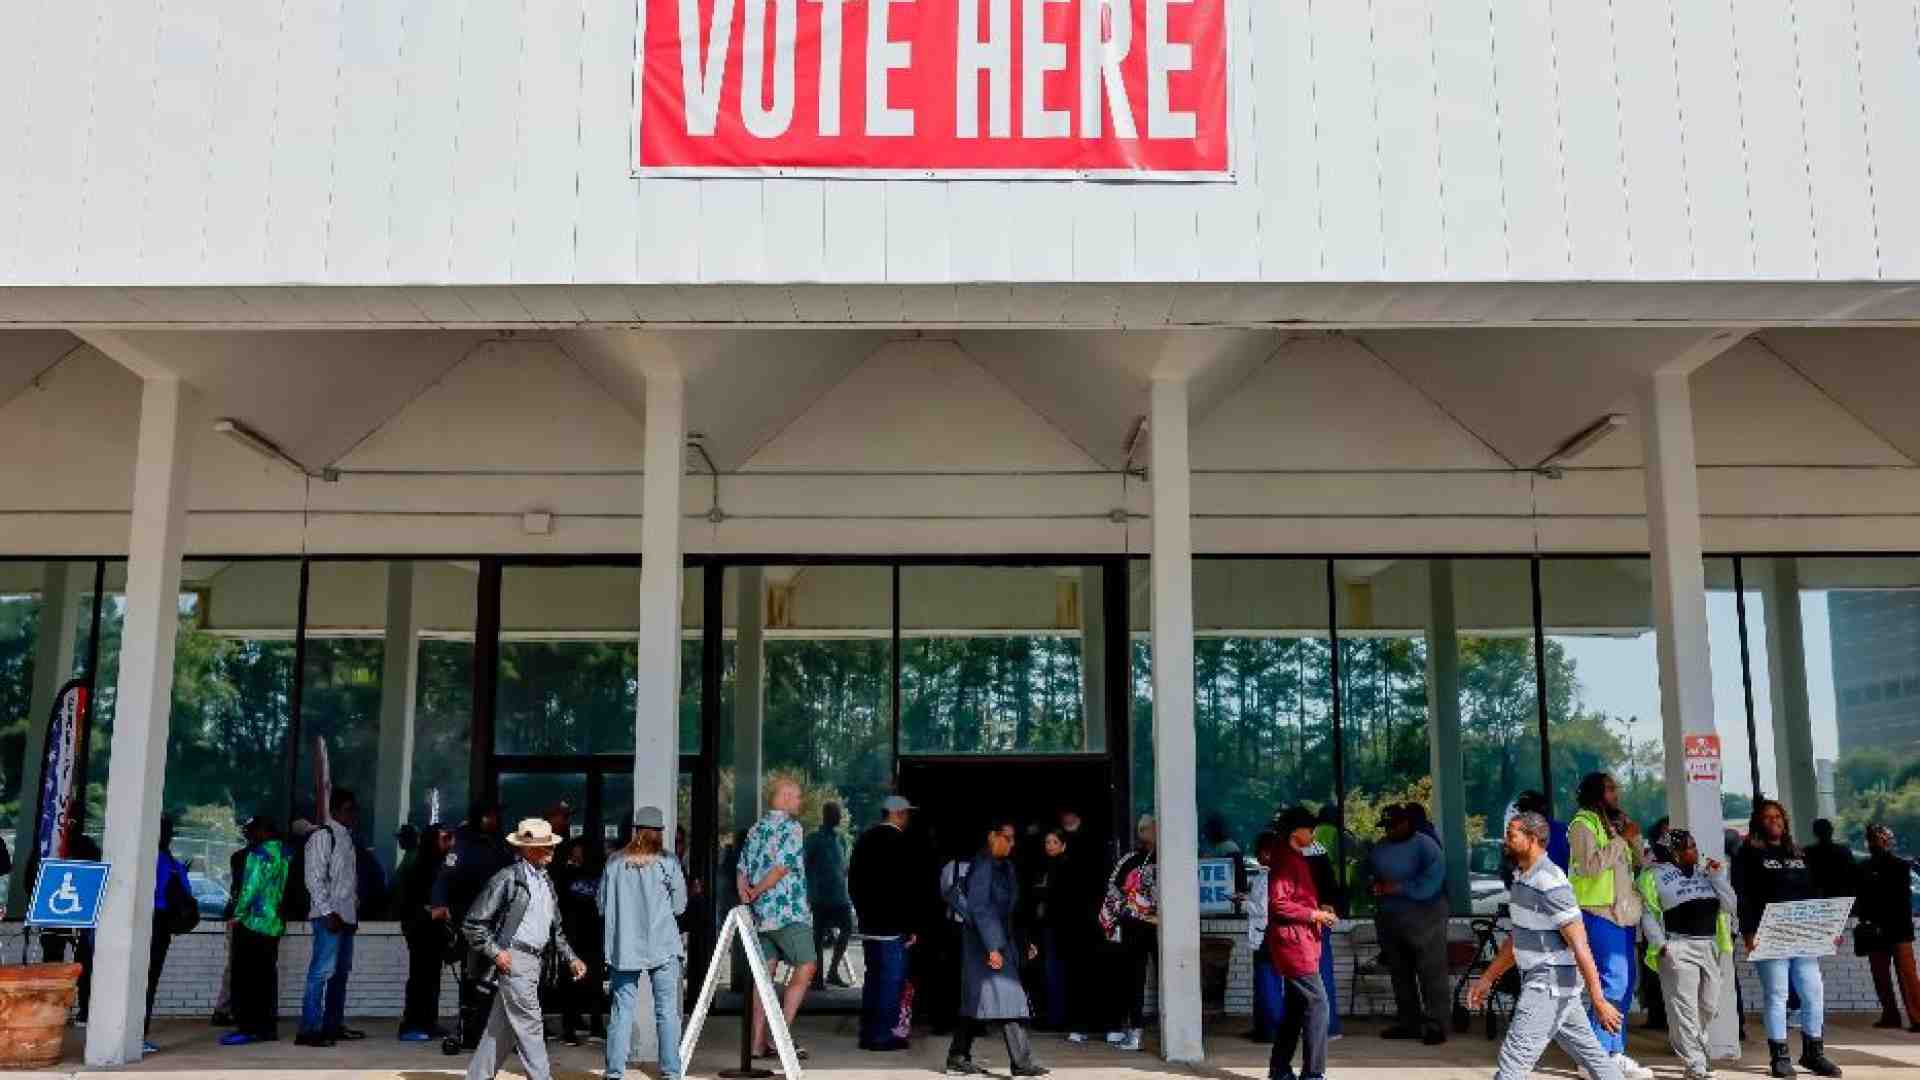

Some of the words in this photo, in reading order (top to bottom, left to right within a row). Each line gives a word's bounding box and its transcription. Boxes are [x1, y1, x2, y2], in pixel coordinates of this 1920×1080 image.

[678, 0, 915, 137] VOTE
[954, 0, 1197, 139] HERE
[1199, 865, 1225, 881] TE
